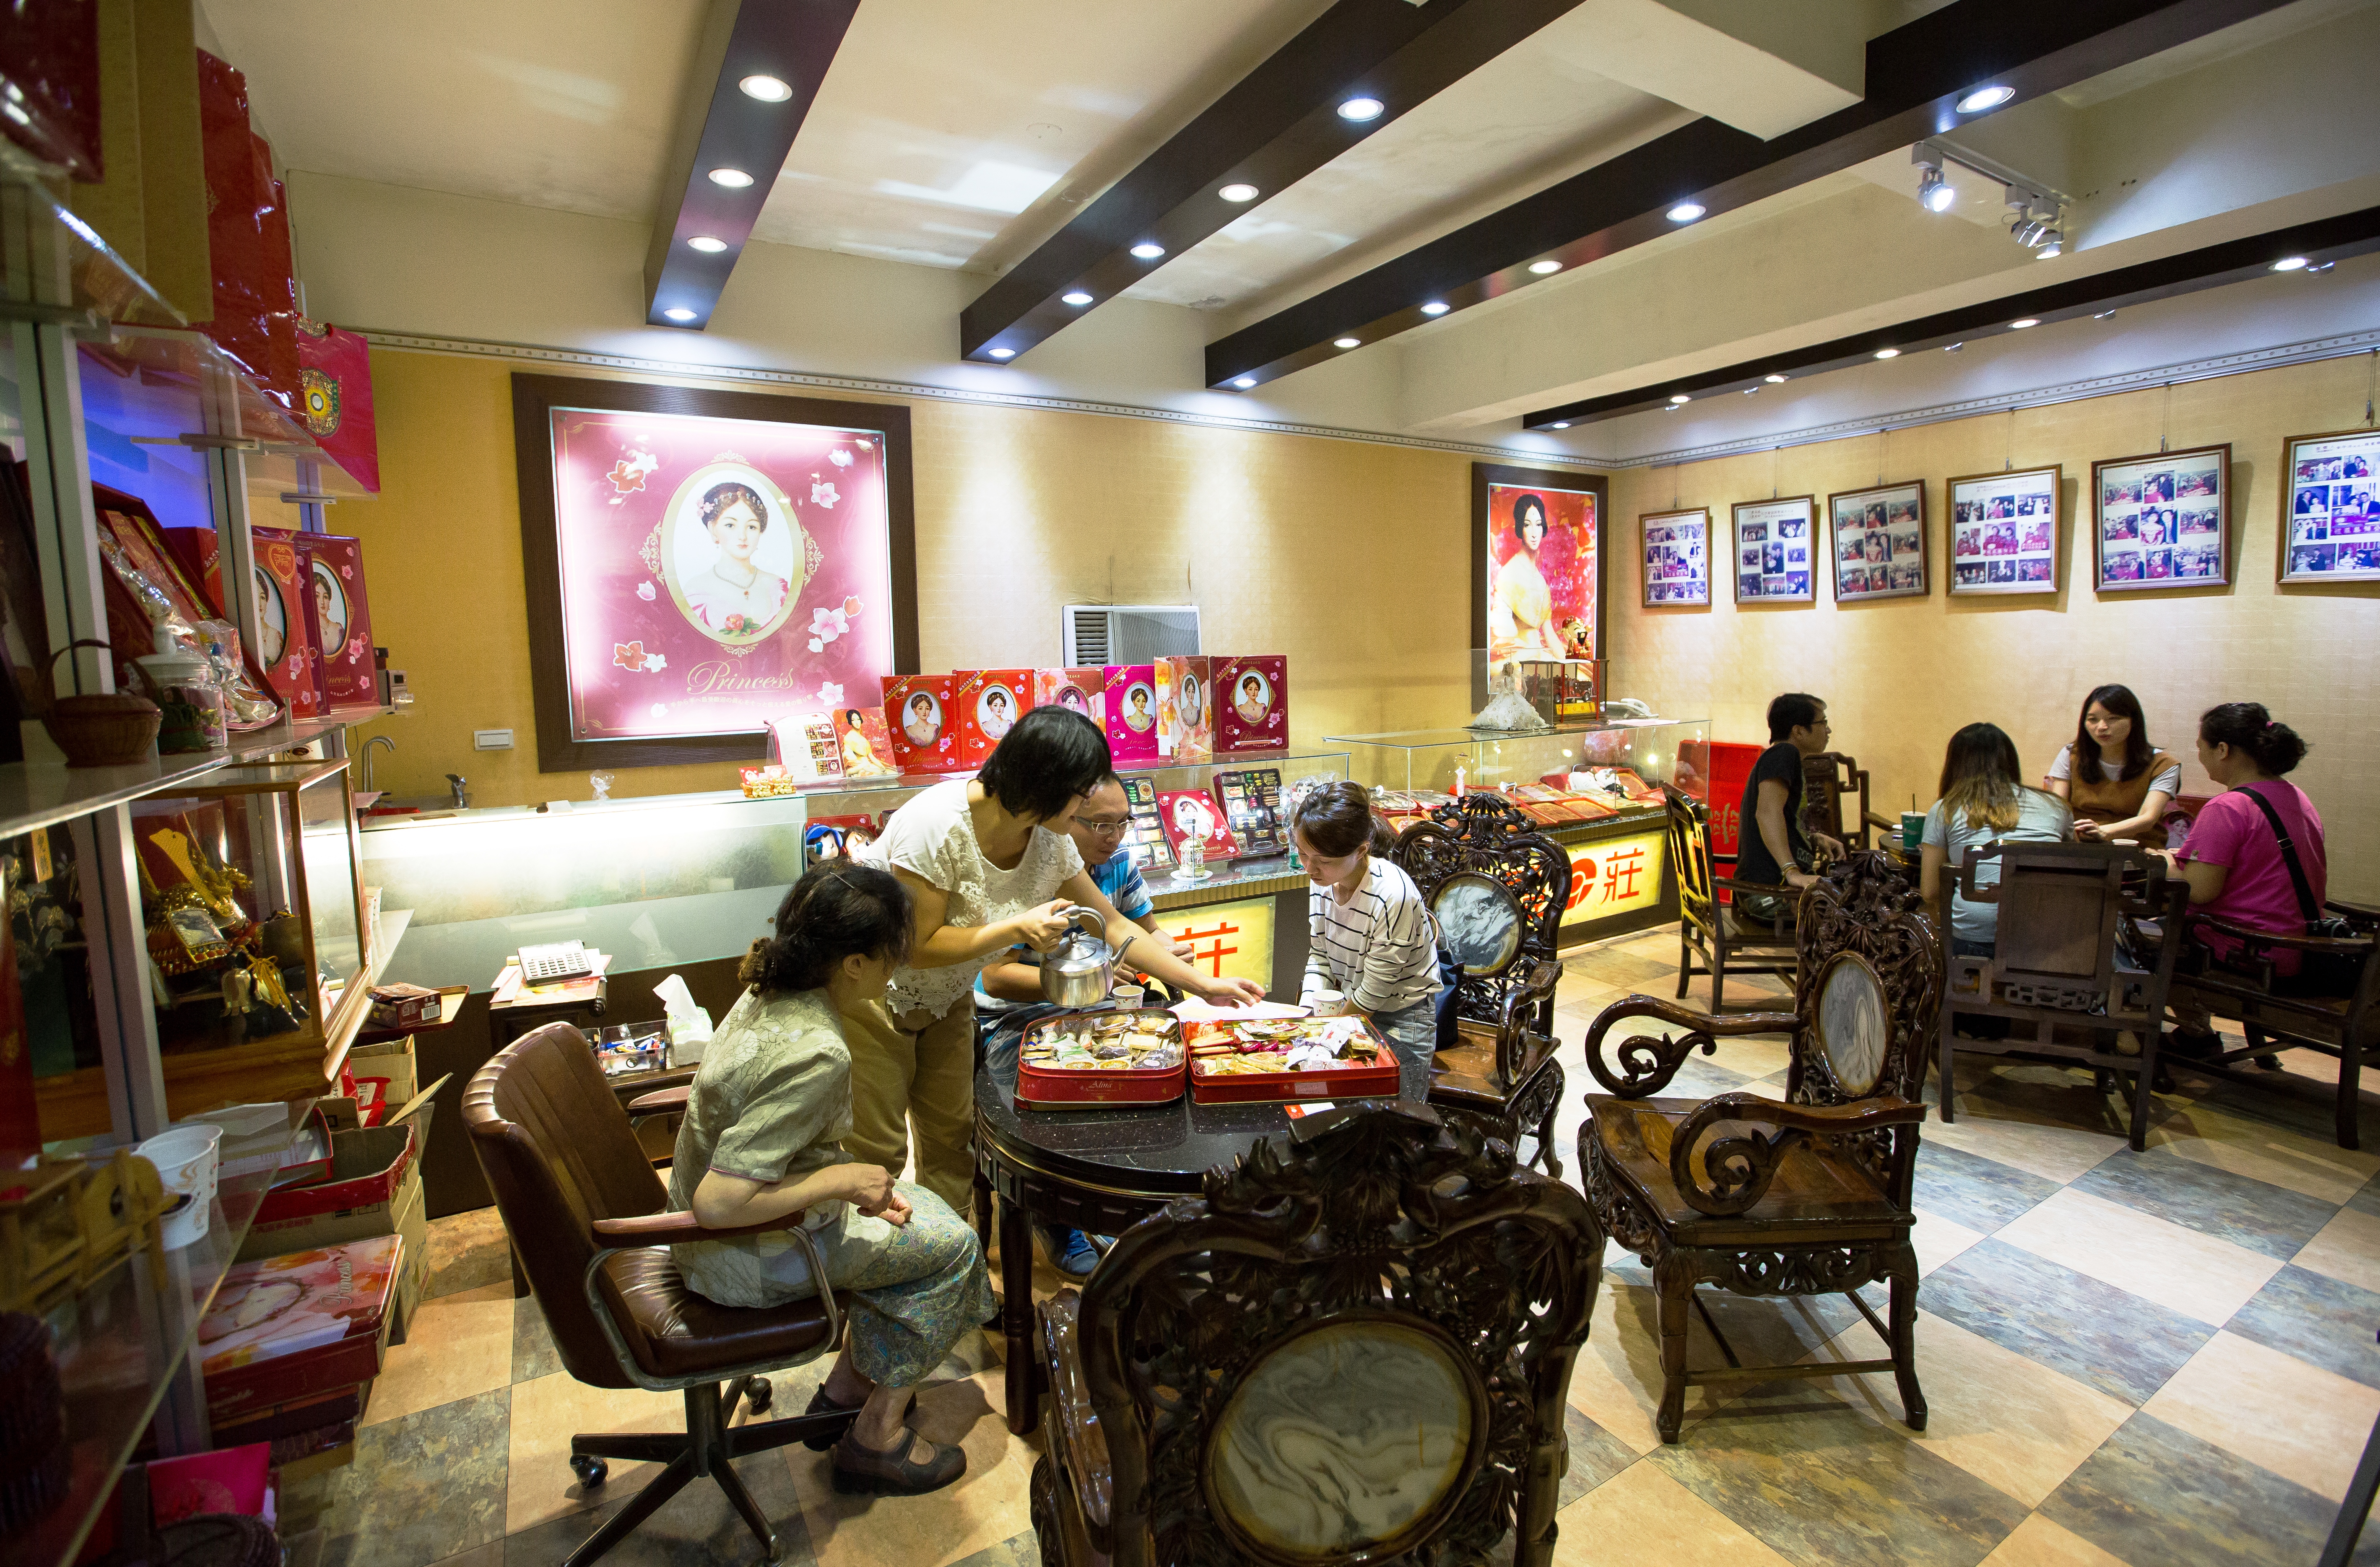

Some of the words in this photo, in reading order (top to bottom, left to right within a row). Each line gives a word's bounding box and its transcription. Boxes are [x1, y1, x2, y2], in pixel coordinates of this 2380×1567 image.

[686, 659, 794, 695] Princess
[1239, 731, 1268, 741] Princess
[1601, 847, 1645, 905] 莊
[320, 1261, 352, 1305] Princess
